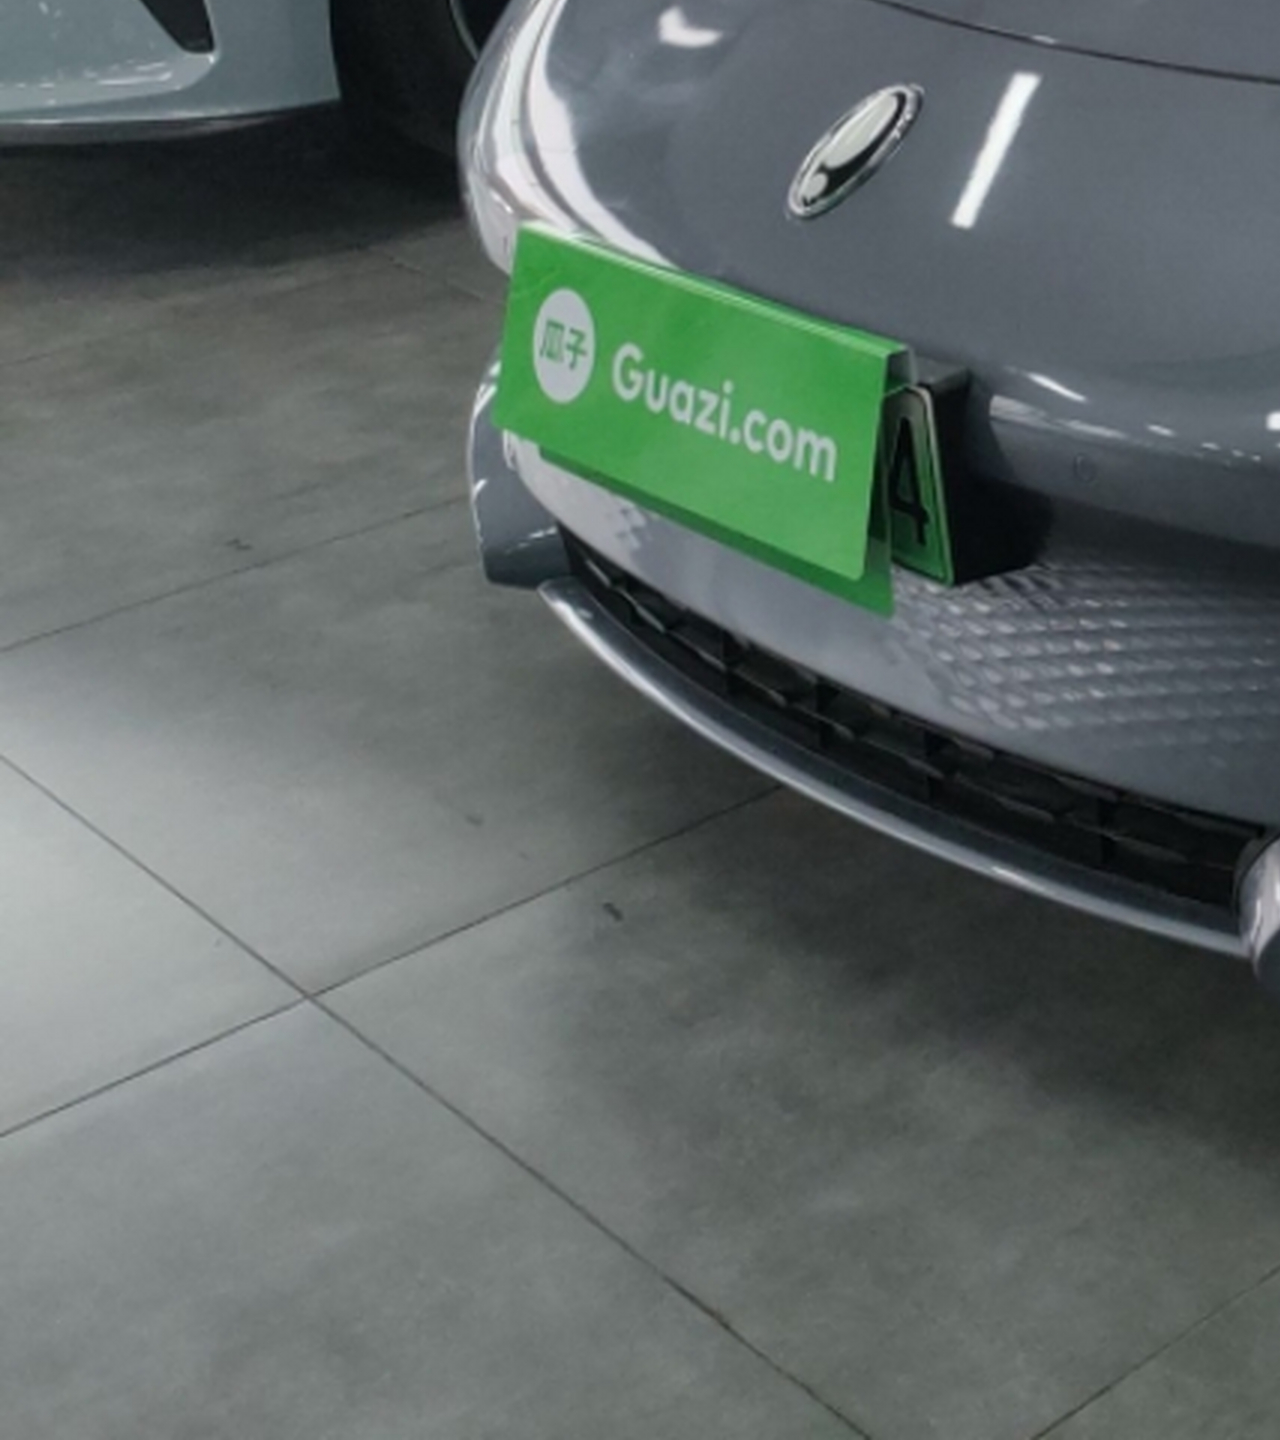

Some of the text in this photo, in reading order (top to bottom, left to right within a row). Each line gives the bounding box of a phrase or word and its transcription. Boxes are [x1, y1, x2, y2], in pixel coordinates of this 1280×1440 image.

[540, 318, 588, 371] 瓜子
[612, 342, 838, 482] Guazi.com
[889, 415, 930, 547] 4
